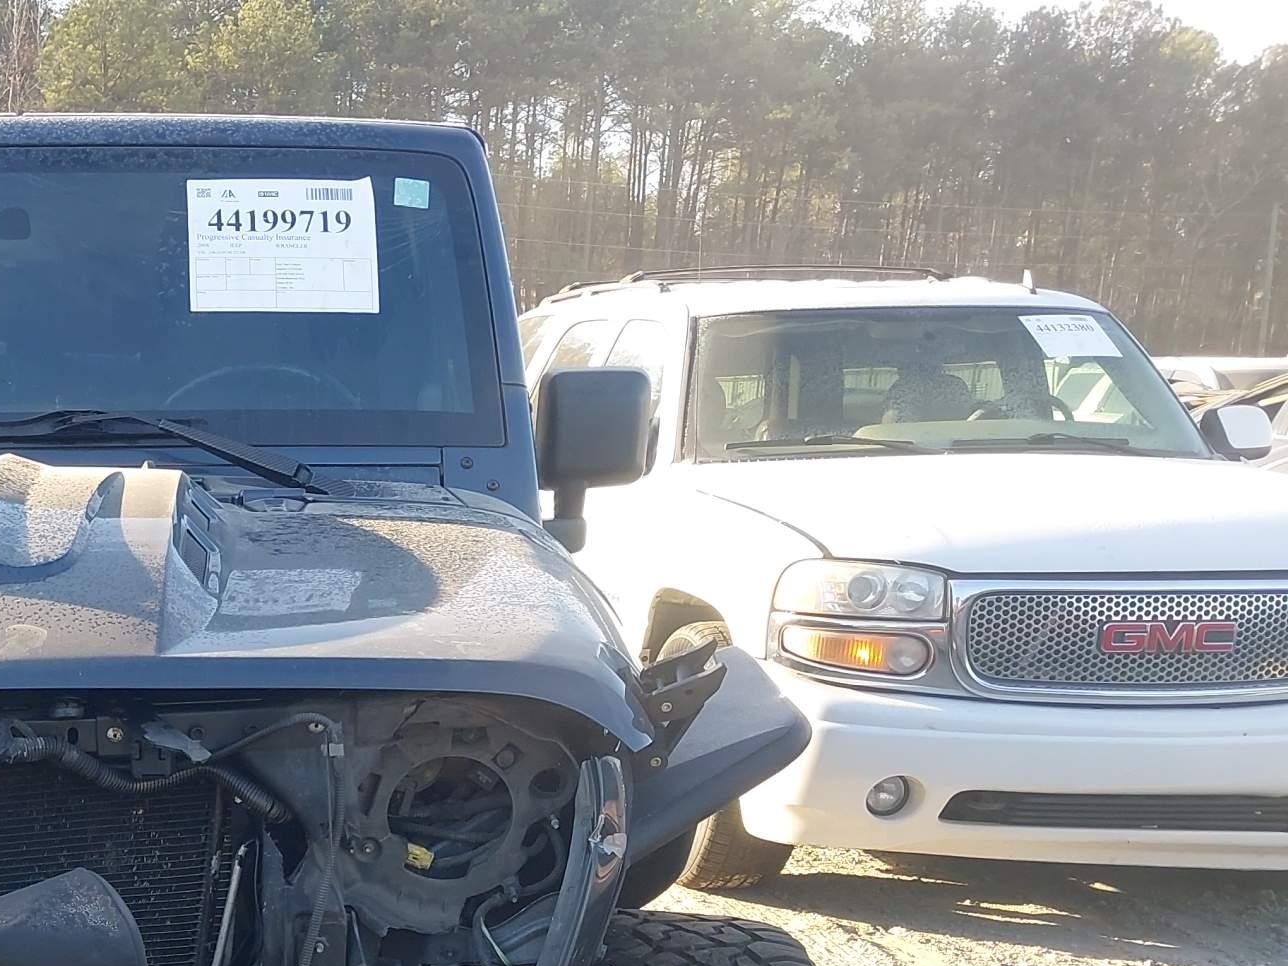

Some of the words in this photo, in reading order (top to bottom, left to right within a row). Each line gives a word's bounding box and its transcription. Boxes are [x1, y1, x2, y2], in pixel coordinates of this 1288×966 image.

[208, 208, 352, 233] 44199719
[196, 233, 239, 242] Progressive
[241, 233, 273, 242] Casualty
[275, 233, 312, 241] Insurance
[1099, 621, 1236, 653] GMC
